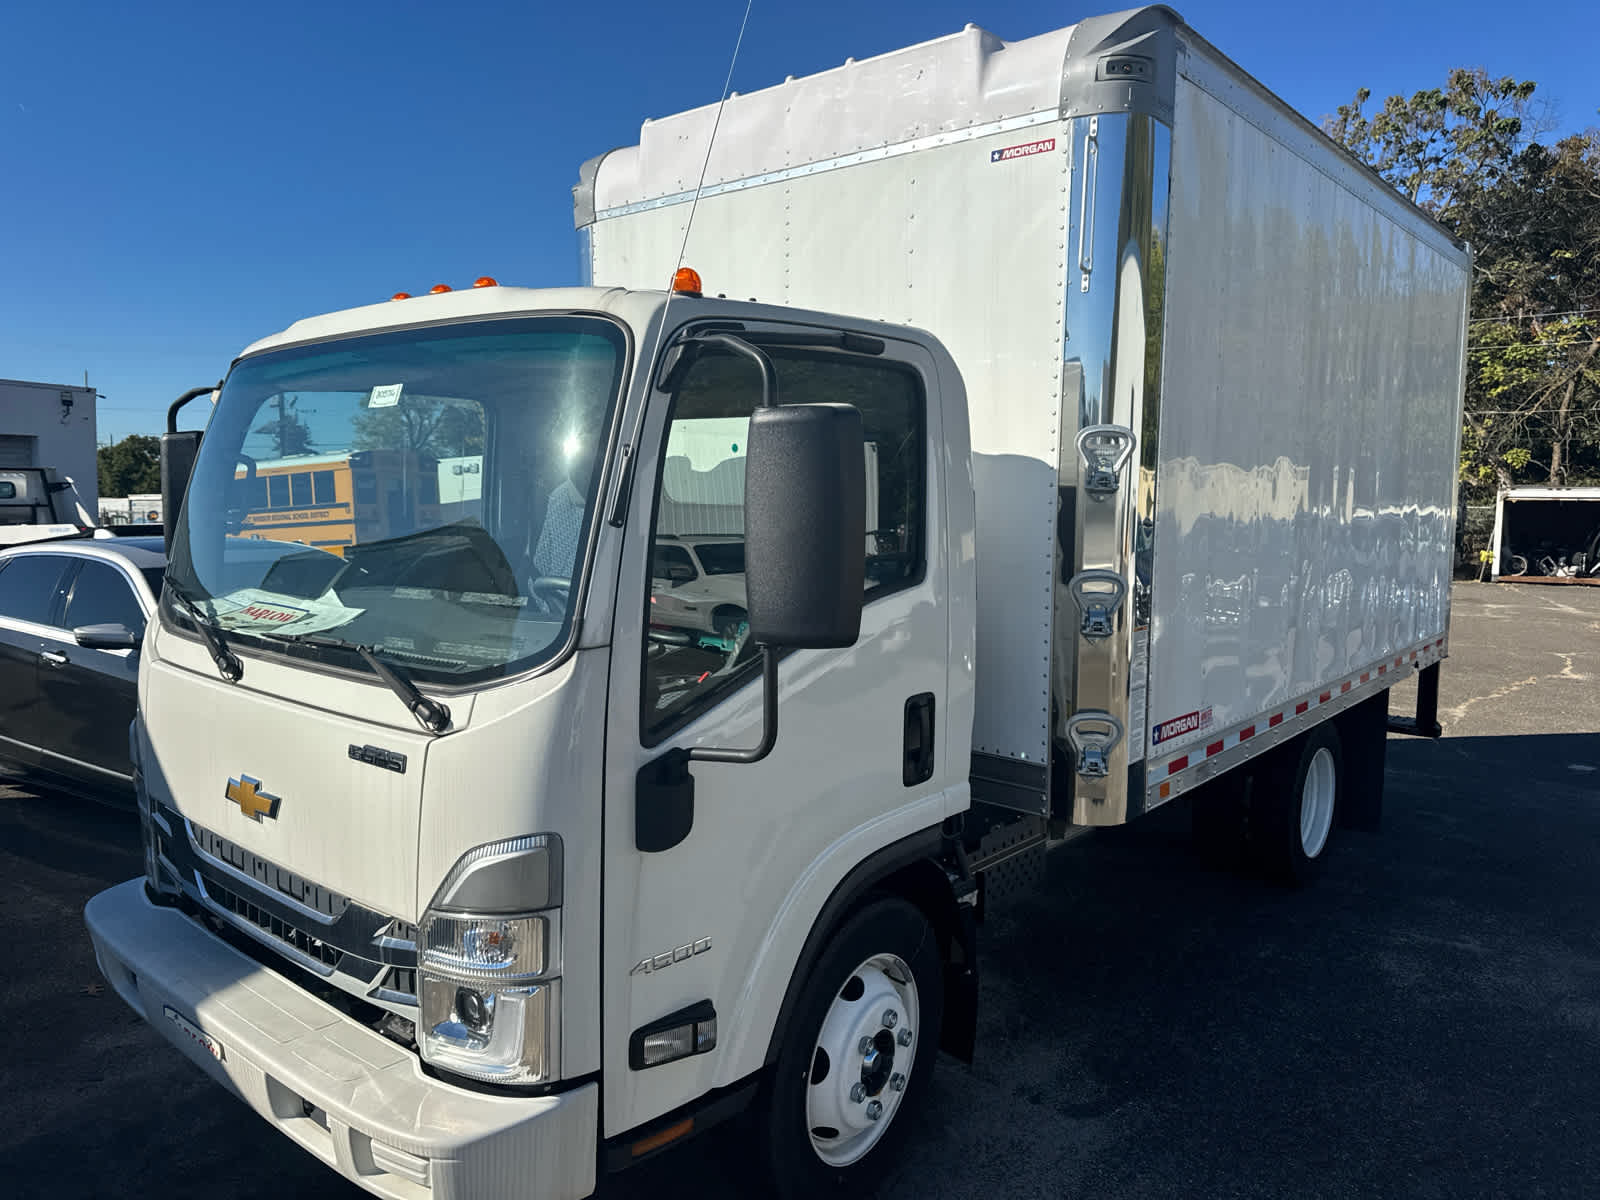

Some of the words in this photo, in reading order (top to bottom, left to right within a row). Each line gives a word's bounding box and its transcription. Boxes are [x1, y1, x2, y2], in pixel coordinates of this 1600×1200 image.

[1002, 141, 1053, 158] MORGAN
[1160, 714, 1198, 740] MORGAN
[630, 936, 712, 976] 4500
